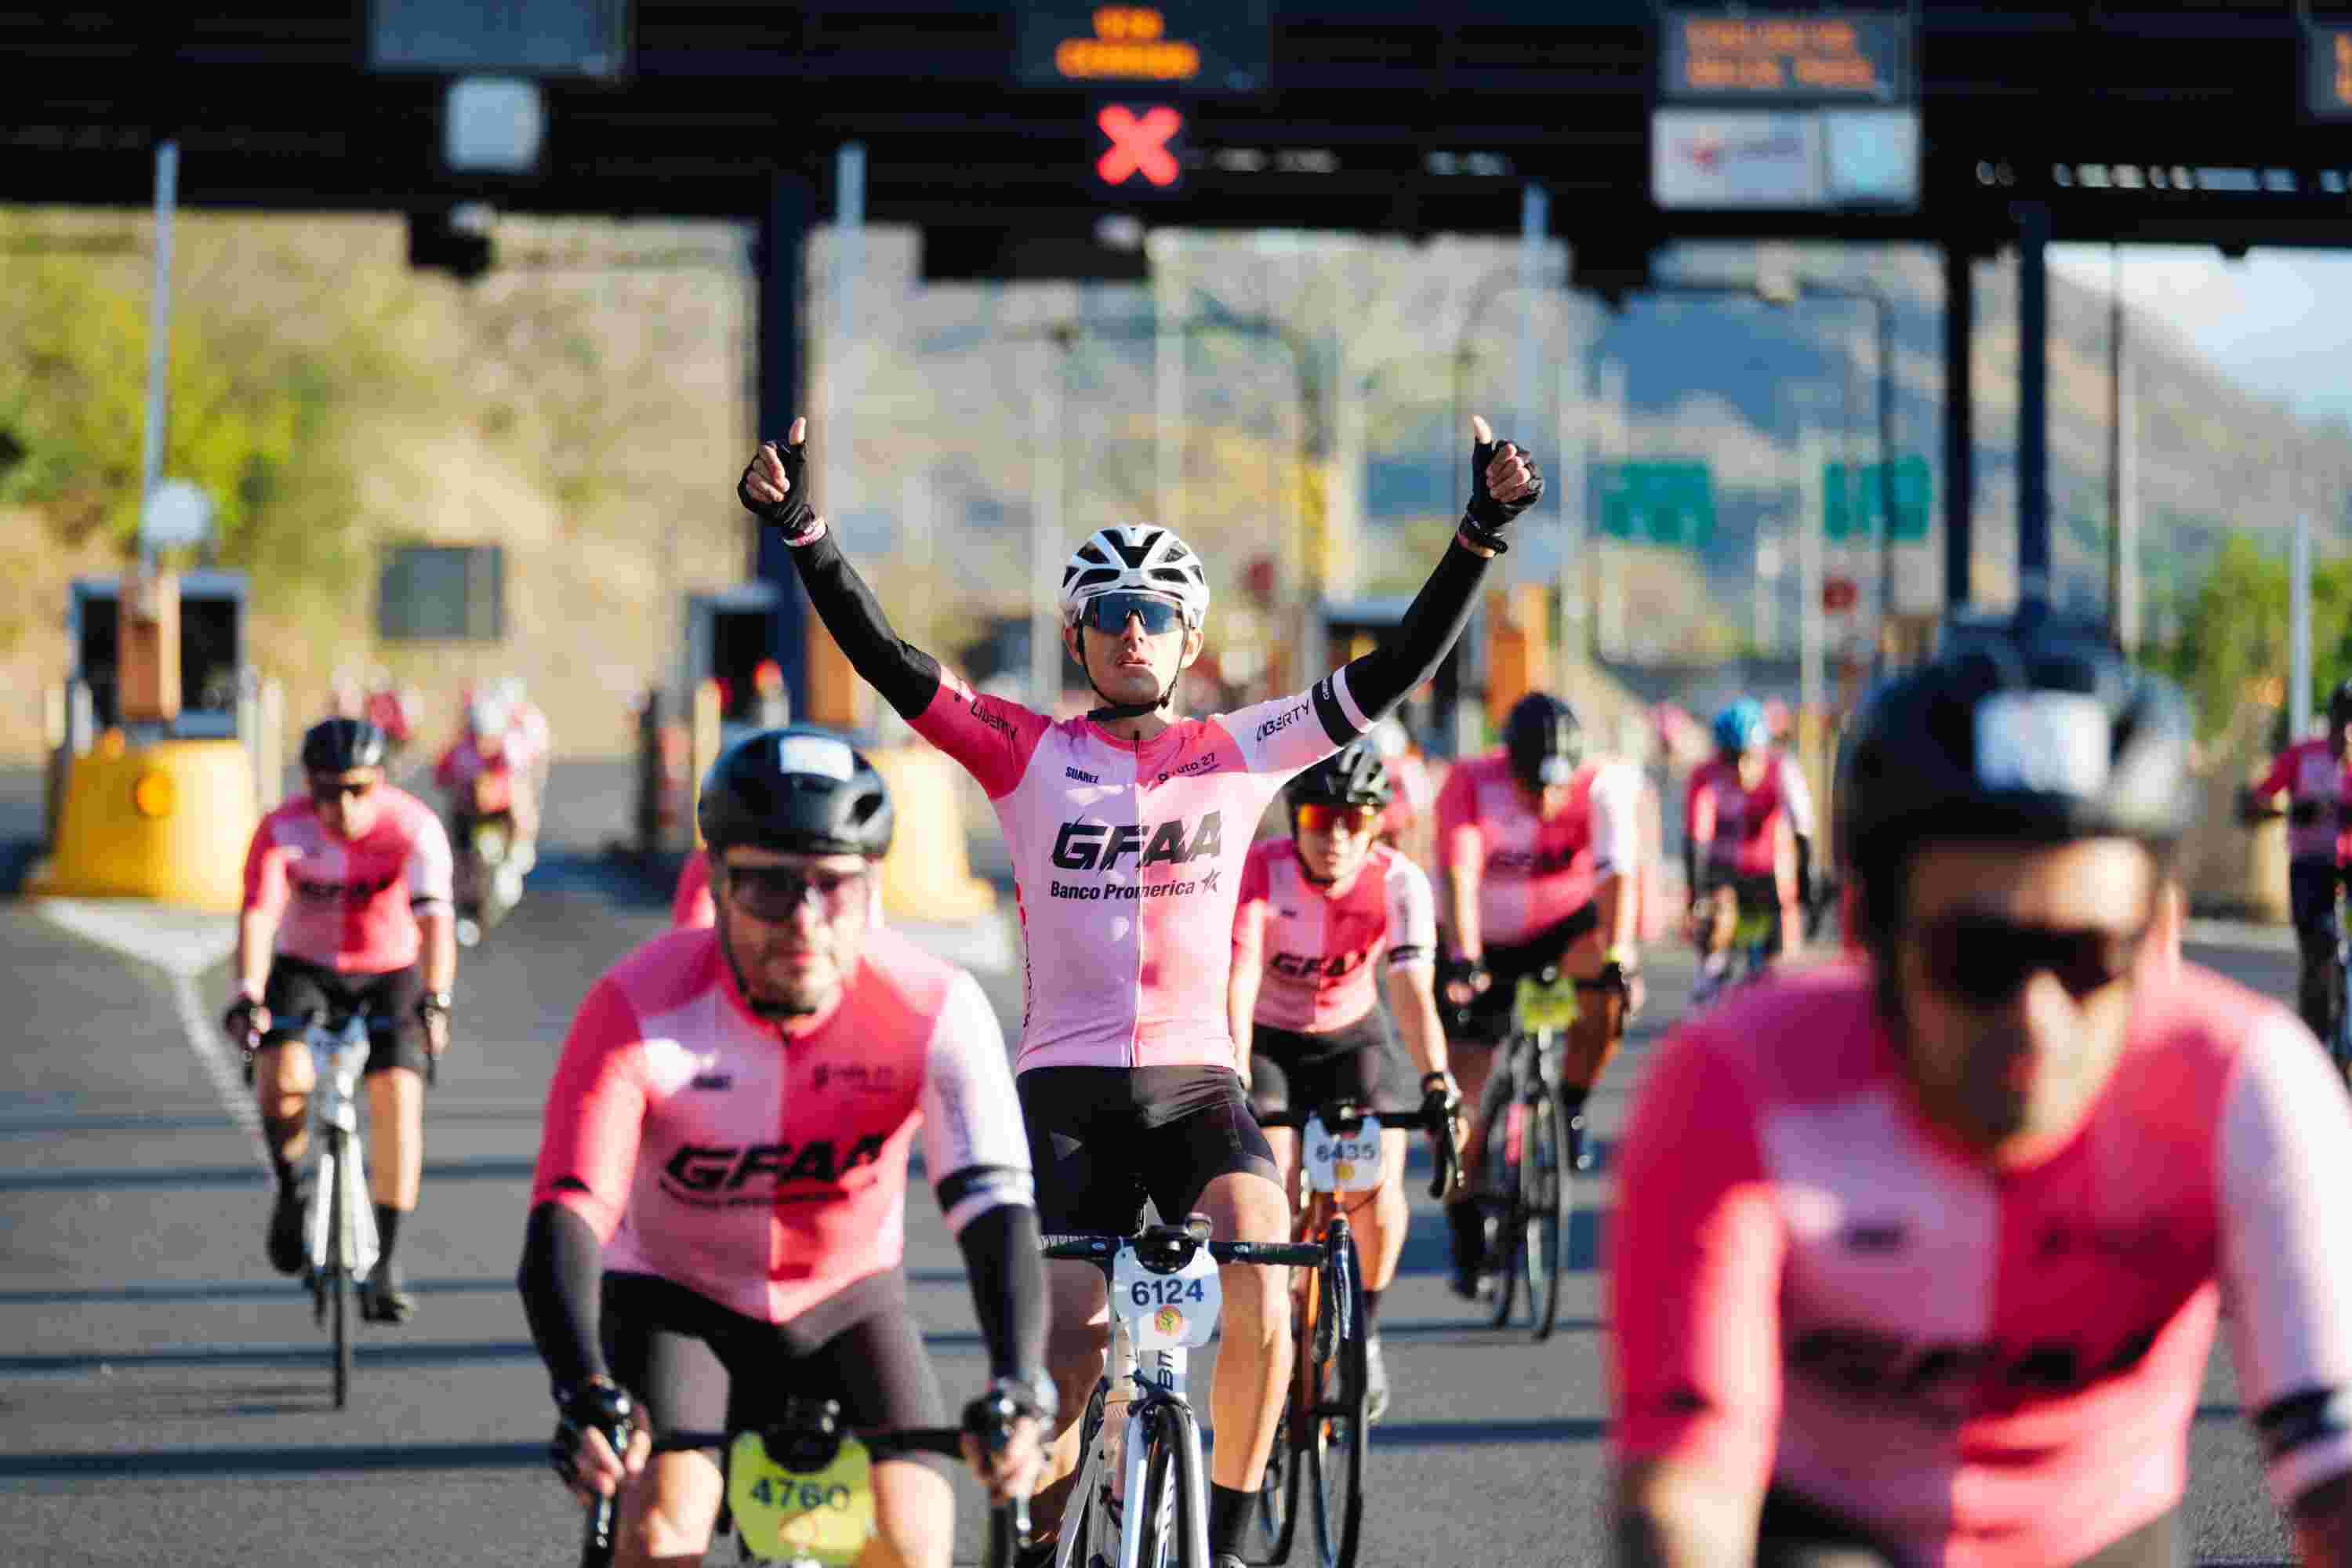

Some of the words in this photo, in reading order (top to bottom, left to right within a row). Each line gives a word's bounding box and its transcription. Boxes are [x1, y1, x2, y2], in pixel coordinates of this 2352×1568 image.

[1256, 698, 1308, 742] LIBERTY
[1201, 752, 1215, 766] 27
[1051, 811, 1221, 873] GFAA
[1050, 880, 1100, 900] Banco
[1103, 879, 1196, 900] Promerica
[1131, 1278, 1205, 1307] 6124
[749, 1477, 851, 1512] 4760
